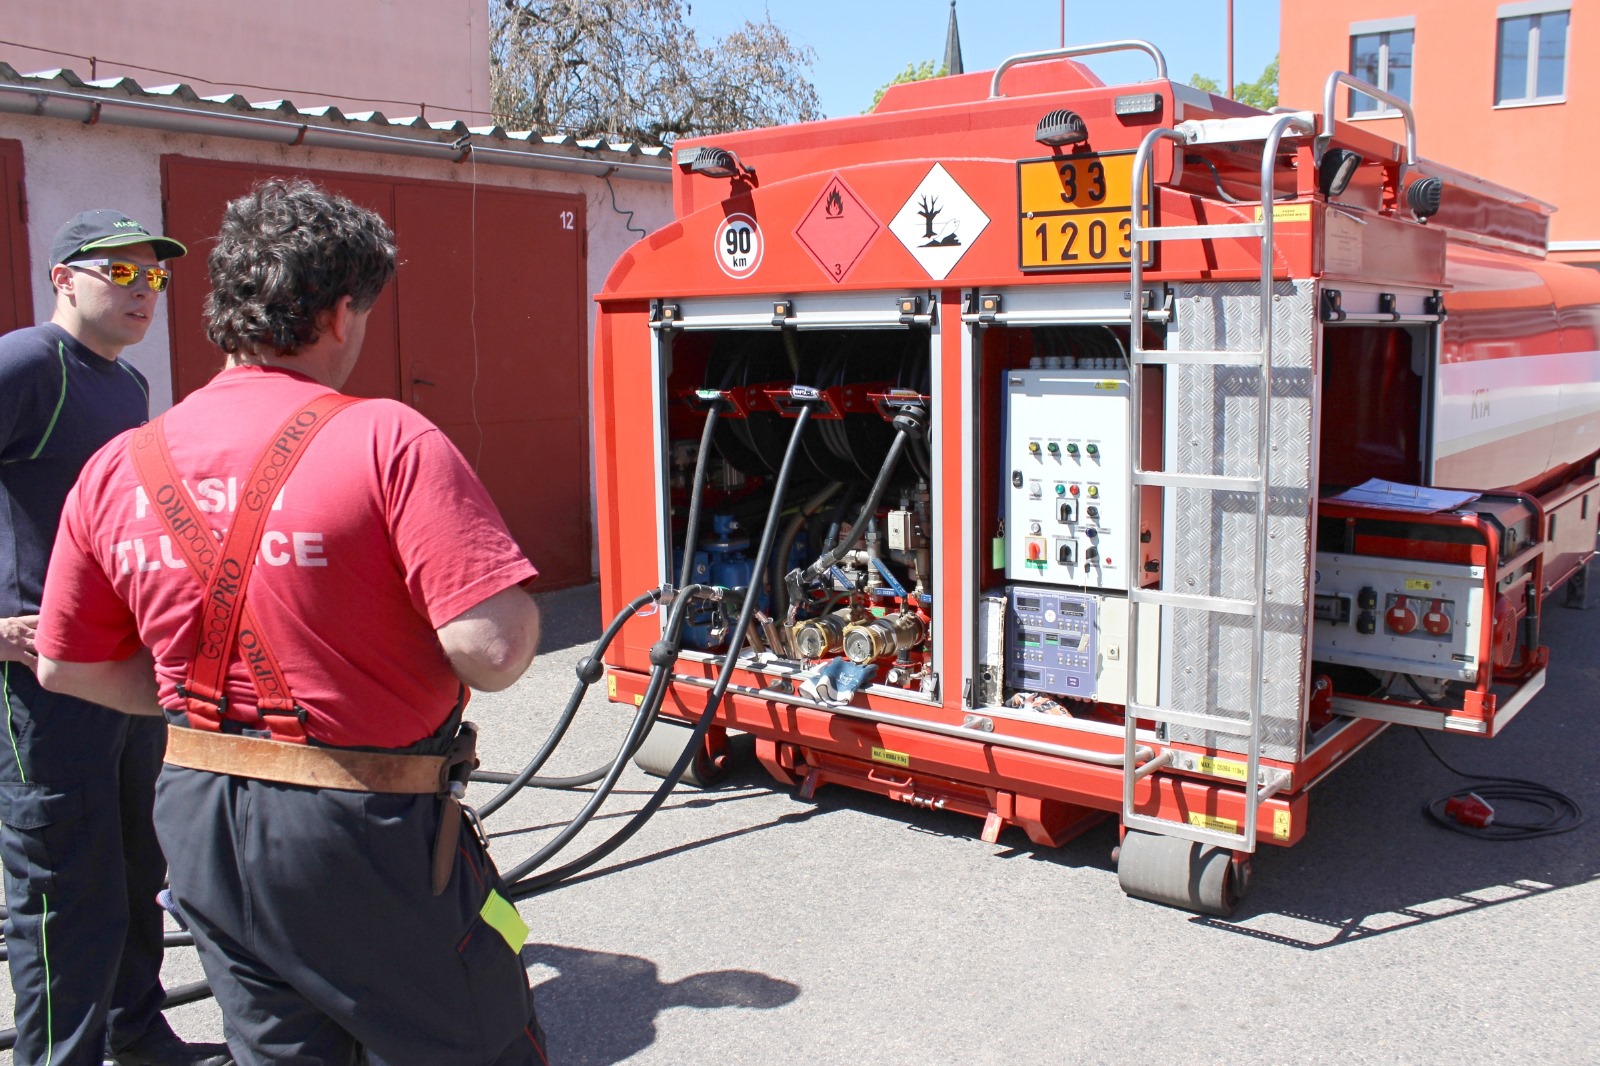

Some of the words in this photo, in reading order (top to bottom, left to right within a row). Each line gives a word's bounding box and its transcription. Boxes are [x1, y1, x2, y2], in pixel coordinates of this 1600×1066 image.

[1060, 161, 1105, 203] 33
[560, 211, 574, 230] 12
[725, 226, 751, 255] 90
[1035, 217, 1132, 262] 1203
[732, 256, 747, 268] km
[834, 263, 842, 276] 3
[245, 410, 318, 512] GoodPRO
[201, 558, 241, 660] GoodPRO
